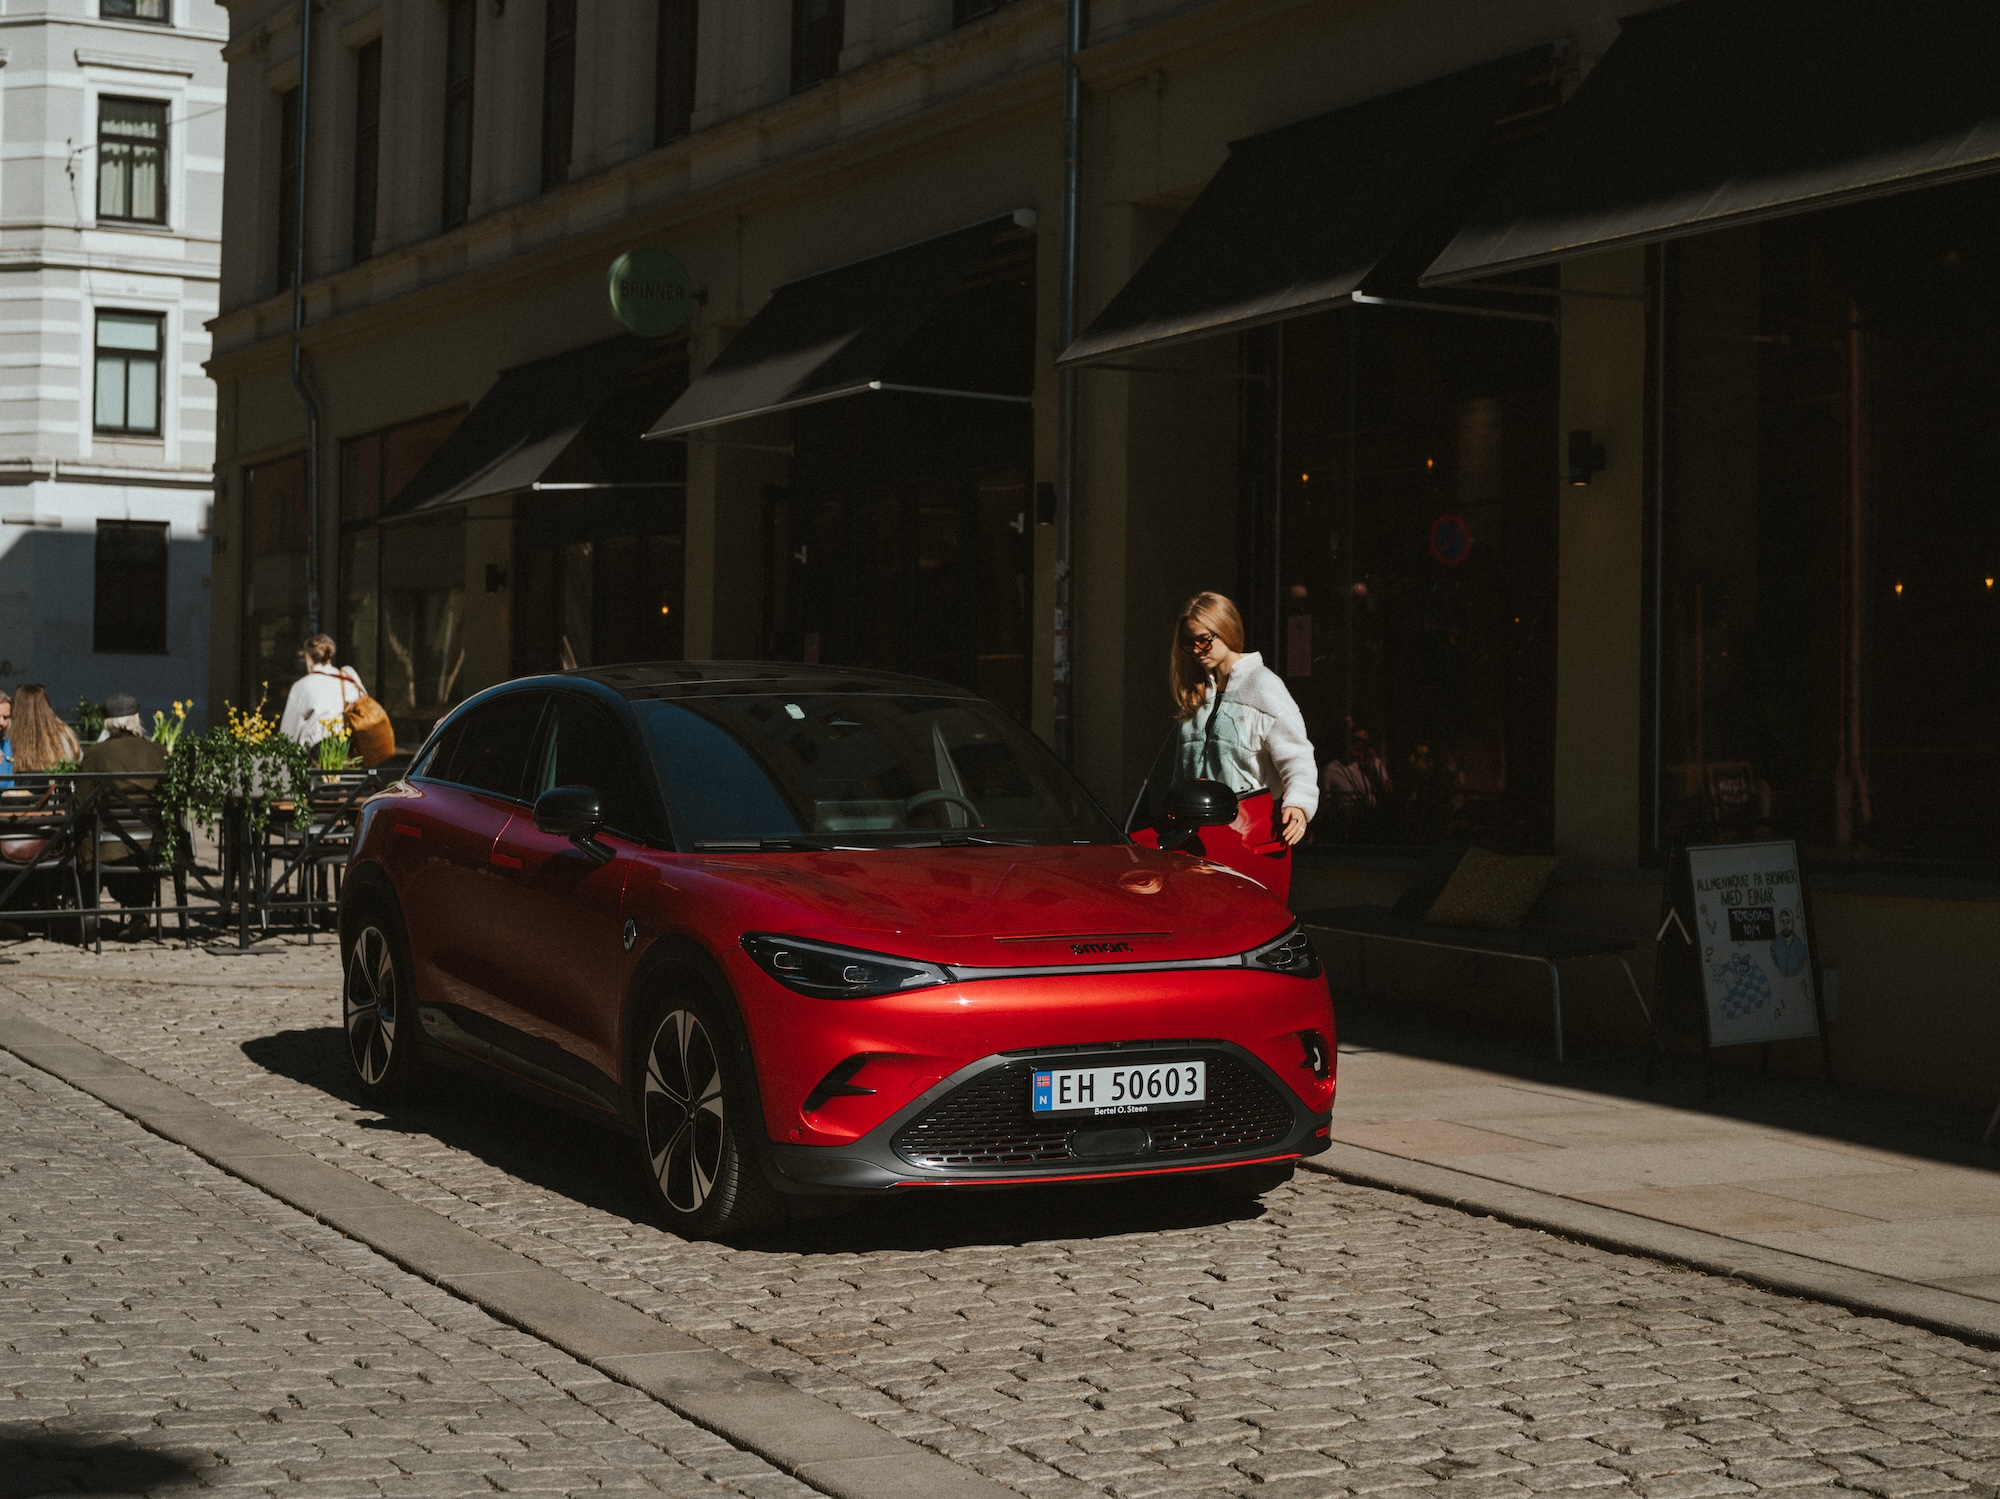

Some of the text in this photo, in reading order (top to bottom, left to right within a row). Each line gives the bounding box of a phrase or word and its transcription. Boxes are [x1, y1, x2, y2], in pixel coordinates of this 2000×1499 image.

[622, 280, 684, 301] BRINNER
[1697, 874, 1749, 892] ALLMENNQUIZ
[1765, 869, 1797, 886] BRINNER
[1721, 887, 1776, 906] MED EINAR
[1731, 910, 1770, 923] TORSDAG
[1070, 942, 1134, 955] smart
[1059, 1066, 1198, 1104] EH 50603
[1039, 1096, 1048, 1105] N
[1094, 1105, 1148, 1116] Bertel O. Steen
